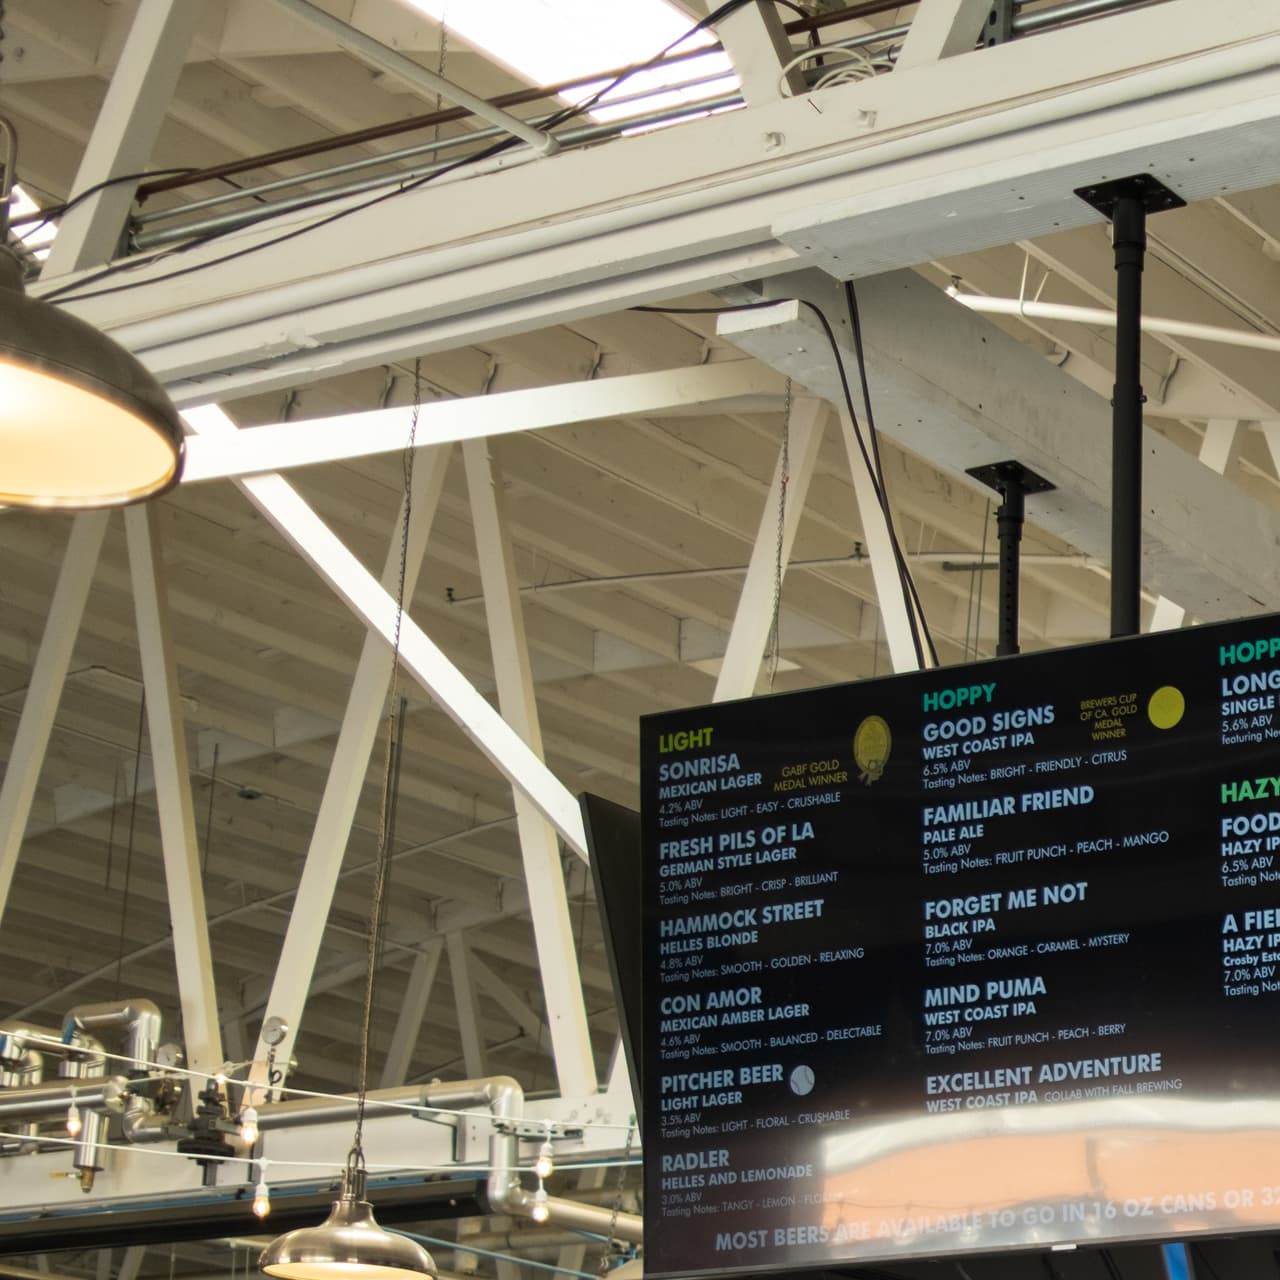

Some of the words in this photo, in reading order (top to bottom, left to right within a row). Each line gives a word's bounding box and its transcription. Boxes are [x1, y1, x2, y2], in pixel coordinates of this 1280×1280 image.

[923, 683, 996, 712] HOPPY
[924, 716, 986, 741] GOOD
[992, 705, 1055, 731] SIGNS
[1221, 730, 1262, 745] featuring
[659, 727, 714, 753] LIGHT
[659, 753, 740, 781] SONRISA
[659, 776, 721, 799] MEXICAN
[725, 773, 762, 791] LAGER
[924, 797, 1015, 826] FAMILIAR
[1022, 785, 1094, 812] FRIEND
[660, 910, 756, 937] HAMMOCK
[763, 900, 824, 924] STREET
[925, 983, 980, 1007] MIND
[987, 976, 1046, 1000] PUMA
[662, 1070, 733, 1093] PITCHER
[740, 1064, 783, 1083] BEER
